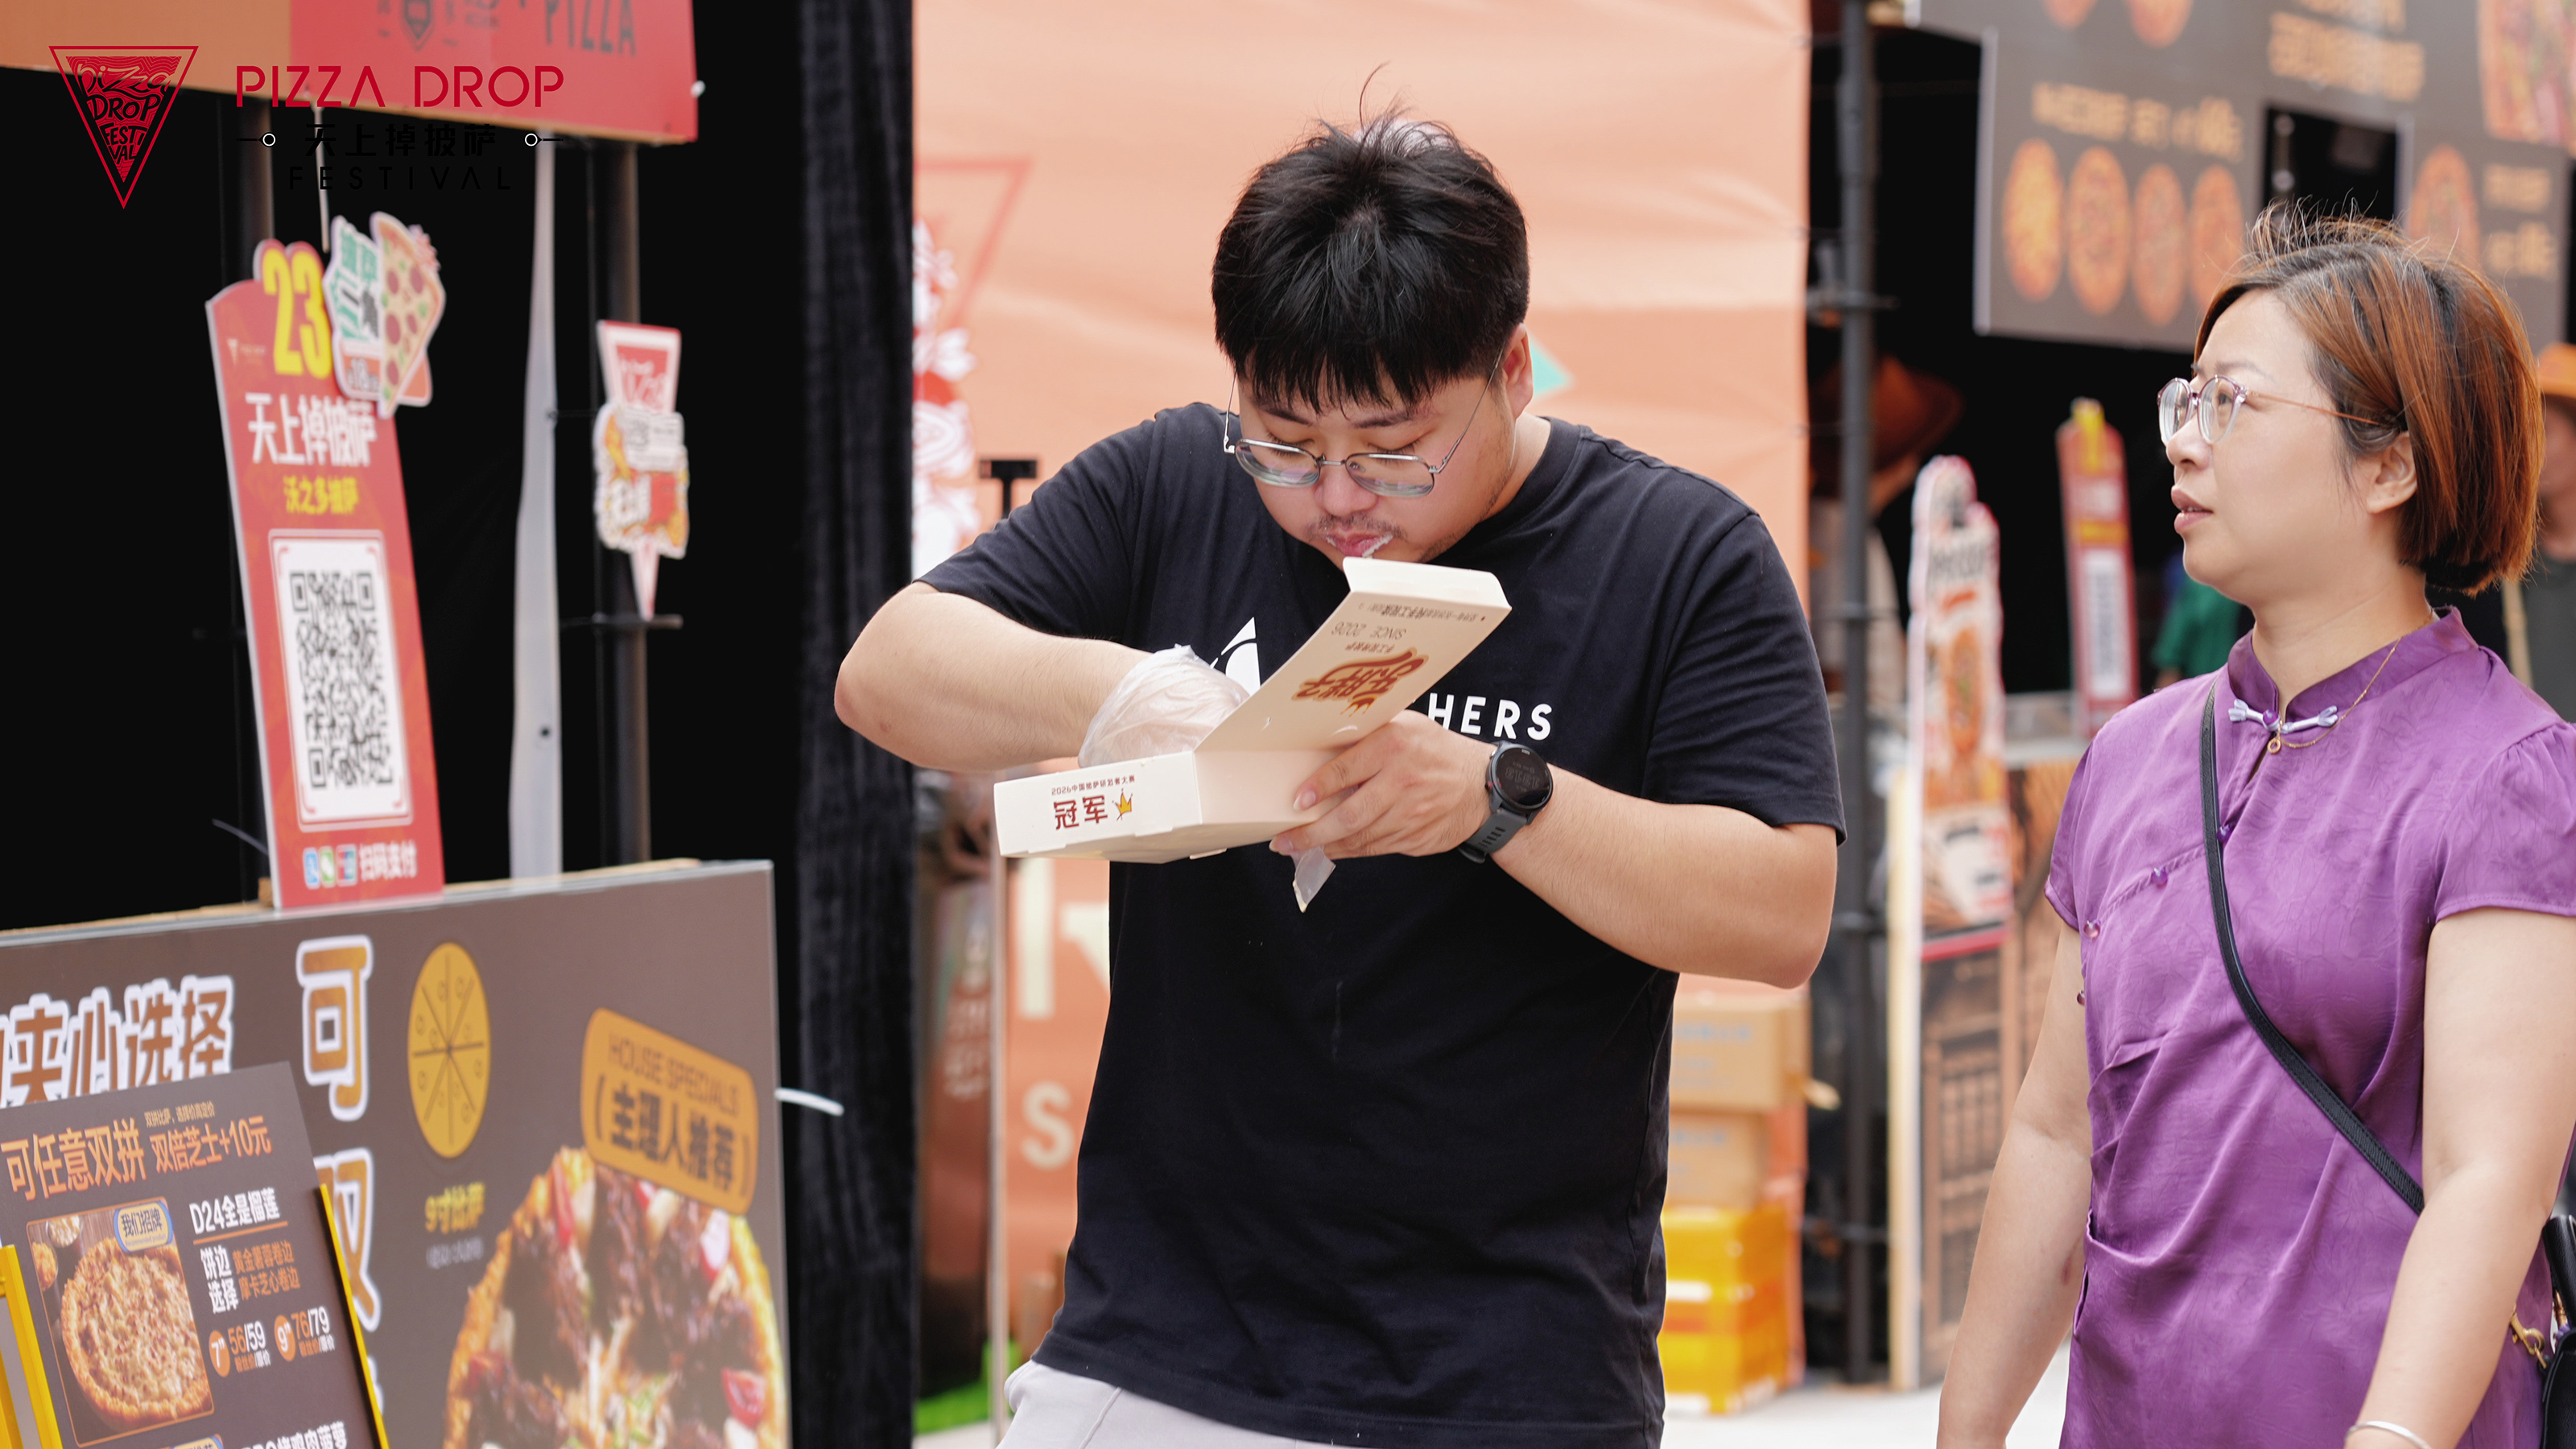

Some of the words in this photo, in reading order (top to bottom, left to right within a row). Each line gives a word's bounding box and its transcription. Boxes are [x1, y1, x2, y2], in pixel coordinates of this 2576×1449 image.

[262, 248, 333, 379] 23
[1369, 626, 1407, 641] SINCE
[1427, 692, 1553, 741] HERS
[1053, 795, 1108, 831] 冠军
[0, 975, 234, 1106] 夹心选择
[0, 1118, 147, 1202] 可任意双拼
[149, 1114, 273, 1174] 双倍芝士+10元
[121, 1207, 163, 1237] 我们招牌
[188, 1186, 280, 1235] D24全是榴莲
[200, 1244, 233, 1282] 饼边
[207, 1277, 239, 1315] 选择
[227, 1320, 267, 1356] 56/59
[291, 1305, 331, 1340] 76/79
